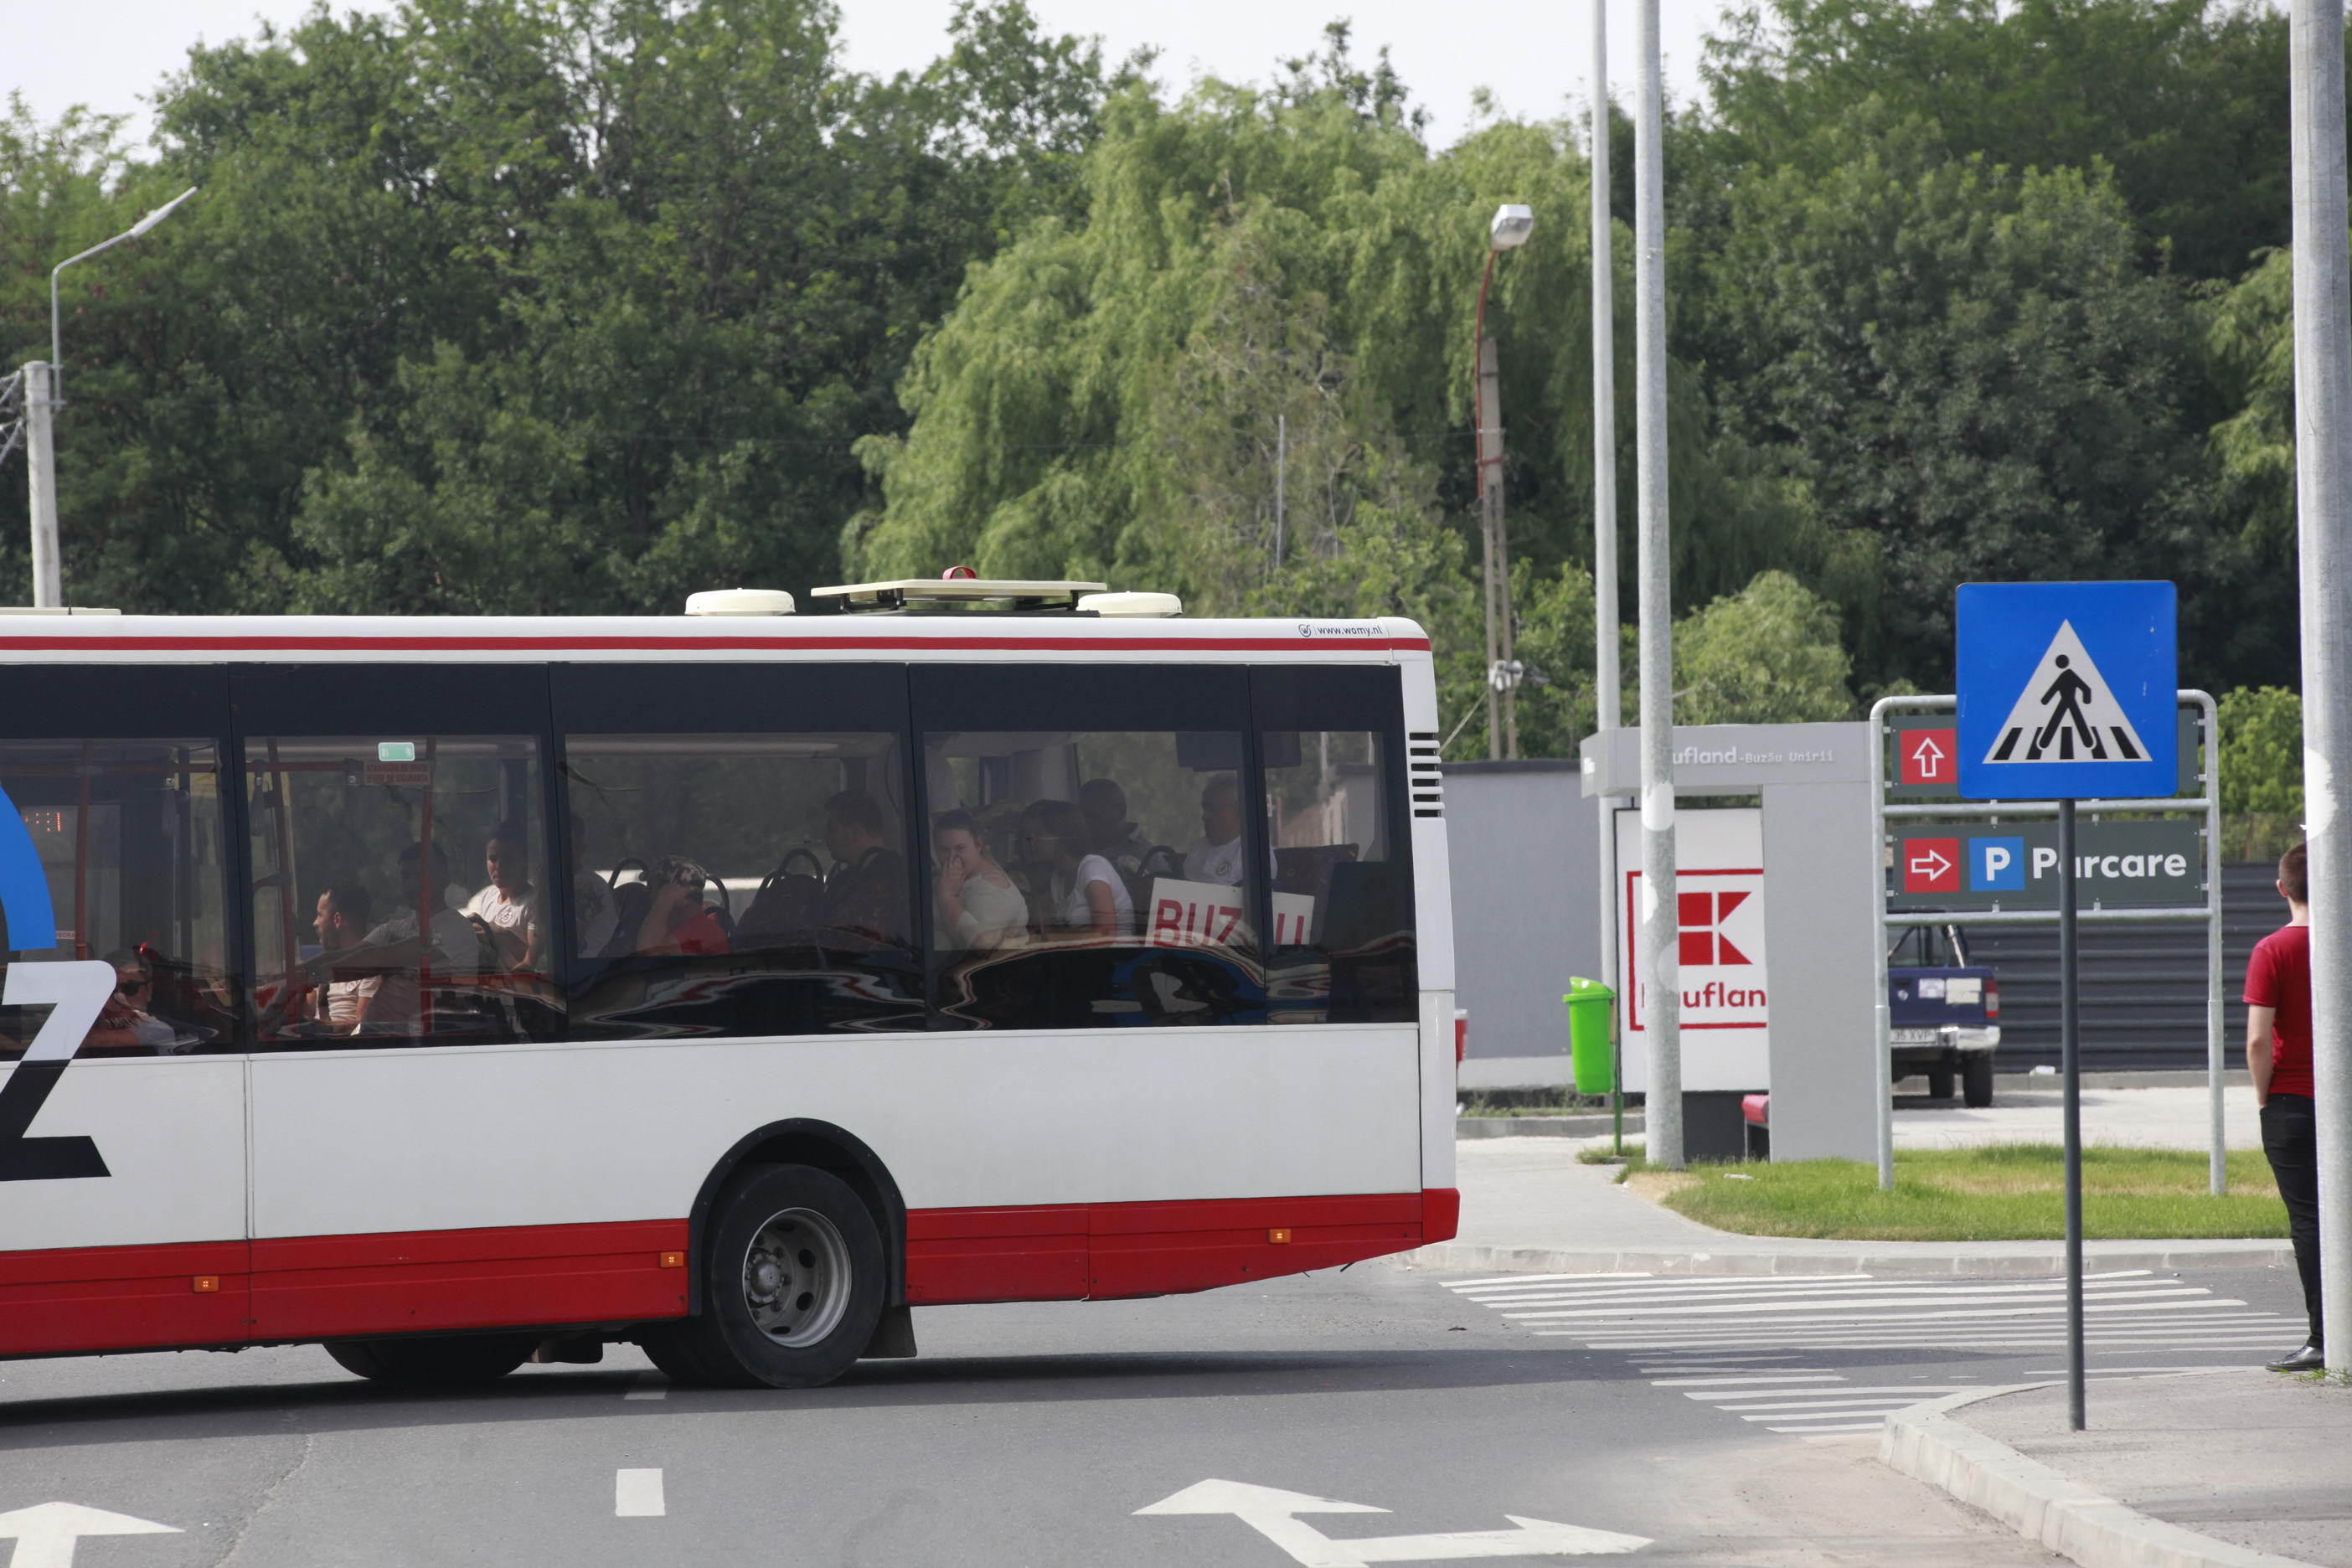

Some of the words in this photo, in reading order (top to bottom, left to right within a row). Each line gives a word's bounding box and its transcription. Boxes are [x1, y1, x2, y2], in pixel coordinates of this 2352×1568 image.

[1317, 626, 1383, 637] www.womy.nl
[1673, 746, 1737, 765] ufland
[1789, 750, 1834, 762] Unirii
[1986, 847, 2010, 881] P
